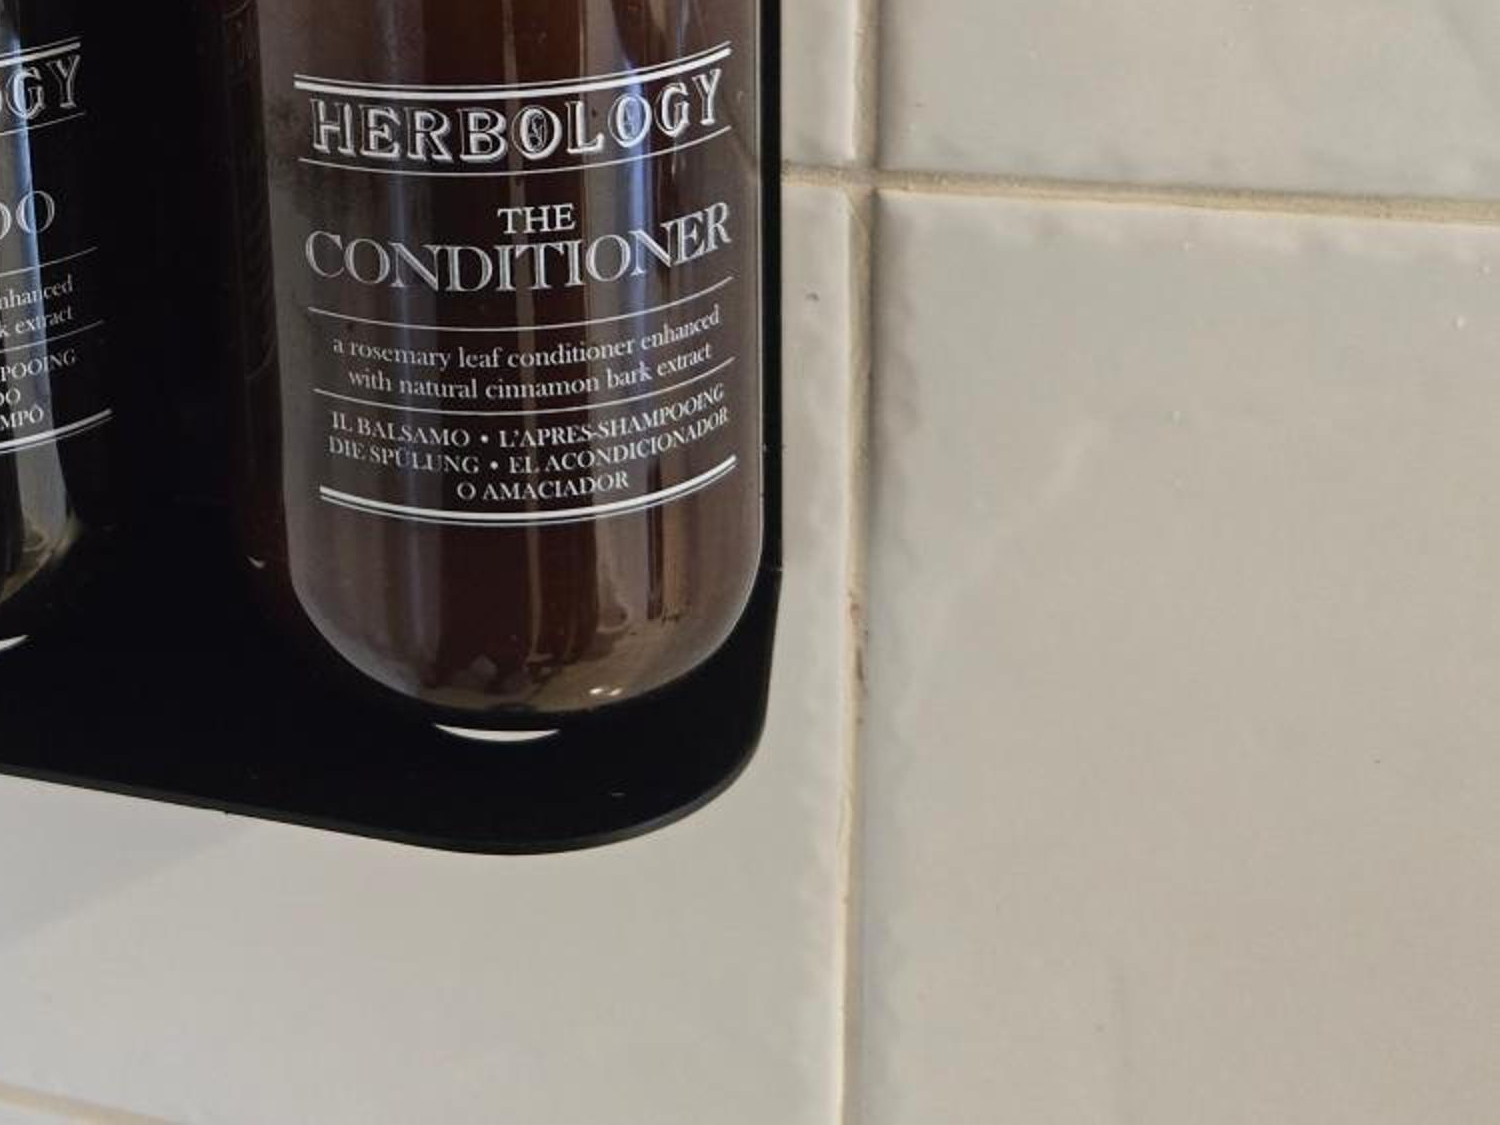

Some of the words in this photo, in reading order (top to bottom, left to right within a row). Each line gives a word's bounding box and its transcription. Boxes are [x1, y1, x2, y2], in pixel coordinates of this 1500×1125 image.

[310, 67, 722, 162] HERBOLOGY
[304, 201, 733, 293] CONDITIONER
[497, 202, 576, 236] THE
[15, 306, 73, 334] extract
[333, 339, 343, 354] a
[350, 340, 450, 372] rosemary
[458, 346, 503, 368] leaf
[507, 340, 636, 368] conditioner
[641, 303, 720, 350] enhanced
[349, 368, 392, 392] with
[400, 378, 478, 399] natural
[485, 376, 599, 400] cinnamon
[607, 360, 653, 389] bark
[657, 343, 712, 377] extract
[328, 435, 365, 460] DIE
[509, 457, 539, 474] EL
[546, 406, 729, 472] ACONDICIONADOR
[332, 410, 353, 432] IL
[358, 416, 470, 448] BALSAMO
[457, 482, 477, 500] O
[483, 470, 629, 500] AMACIADOR
